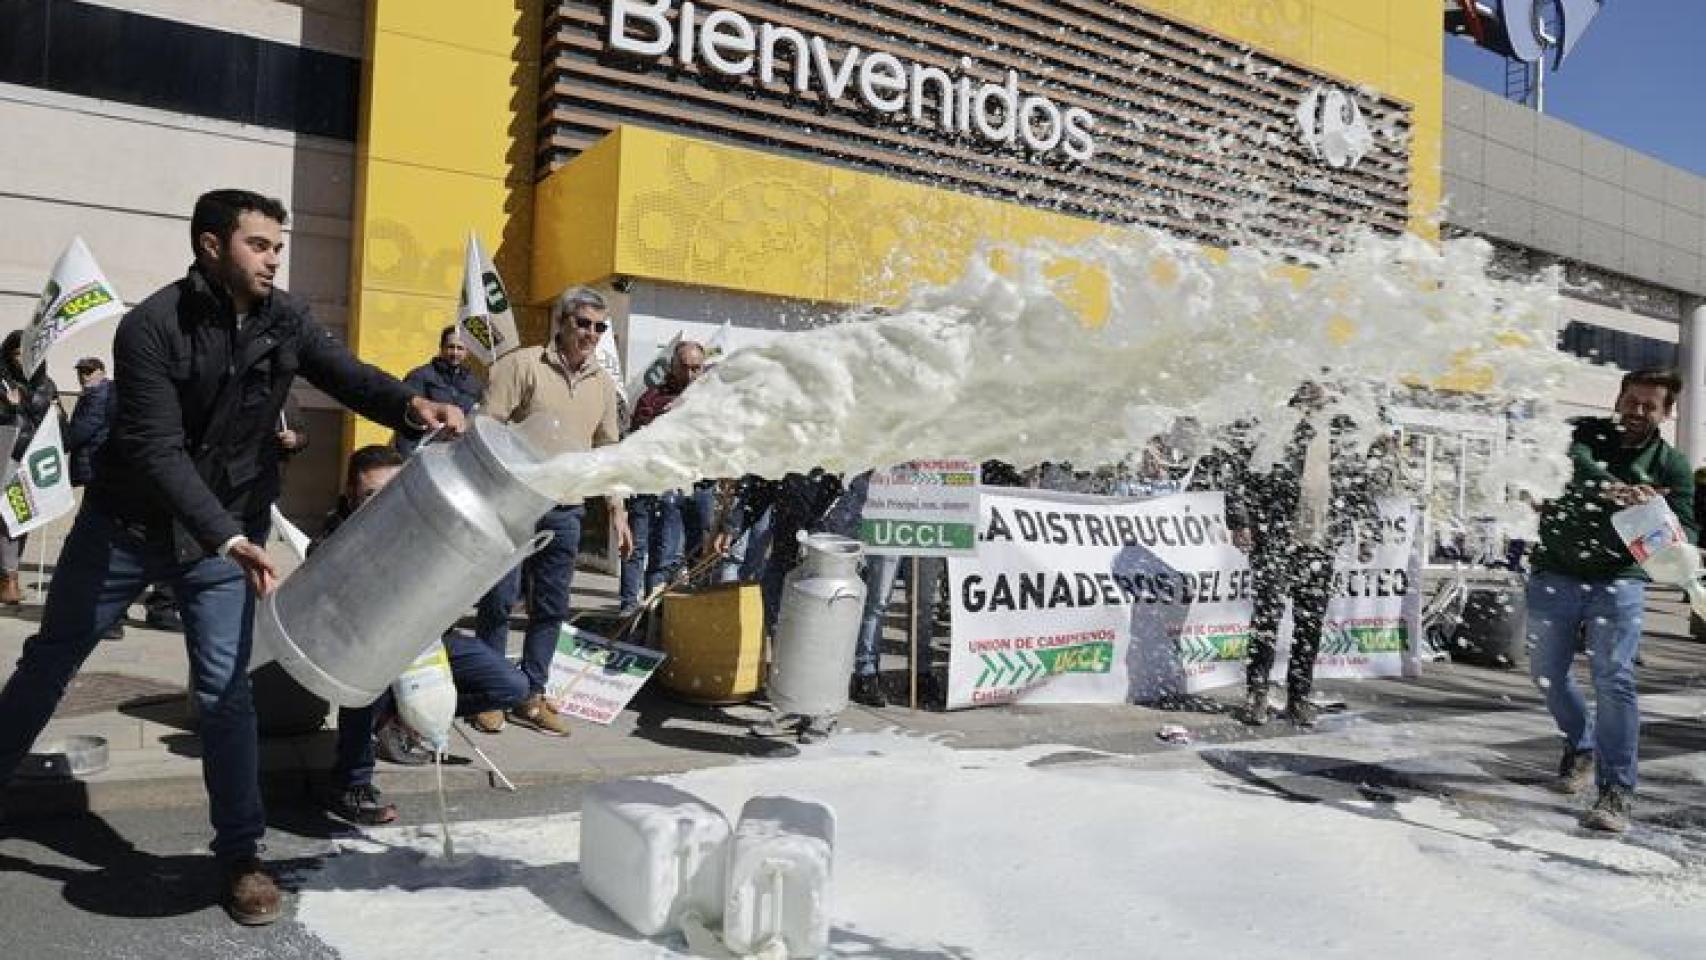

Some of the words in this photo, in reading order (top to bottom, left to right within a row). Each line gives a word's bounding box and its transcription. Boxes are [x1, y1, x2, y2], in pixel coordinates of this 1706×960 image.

[608, 0, 1096, 161] Bienvenidos
[875, 520, 954, 547] UCCL
[978, 506, 1014, 542] A
[1014, 505, 1229, 547] DISTRIBUCIÓN
[961, 571, 1176, 613] GANADEROS
[1181, 570, 1221, 605] DEL
[1016, 636, 1034, 649] DE
